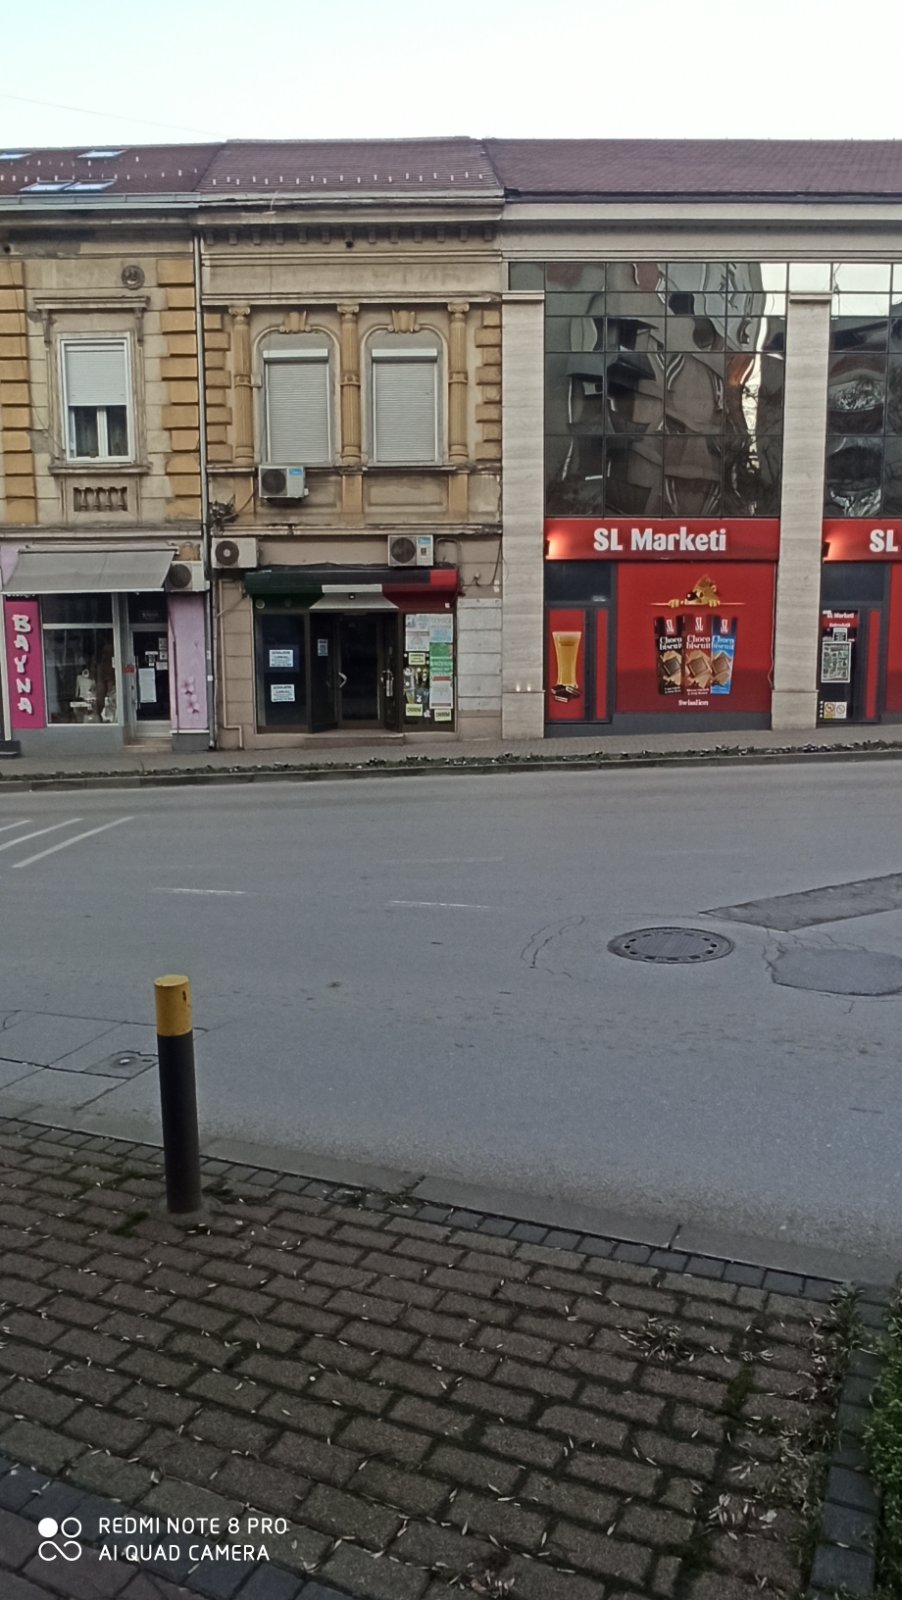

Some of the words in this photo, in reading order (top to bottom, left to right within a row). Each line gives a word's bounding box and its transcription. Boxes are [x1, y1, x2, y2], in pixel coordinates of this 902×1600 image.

[593, 527, 623, 551] SL
[631, 526, 726, 551] Marketi
[869, 529, 899, 552] SL
[695, 616, 703, 631] SL
[686, 634, 711, 642] Choco
[12, 614, 33, 714] BAYNA
